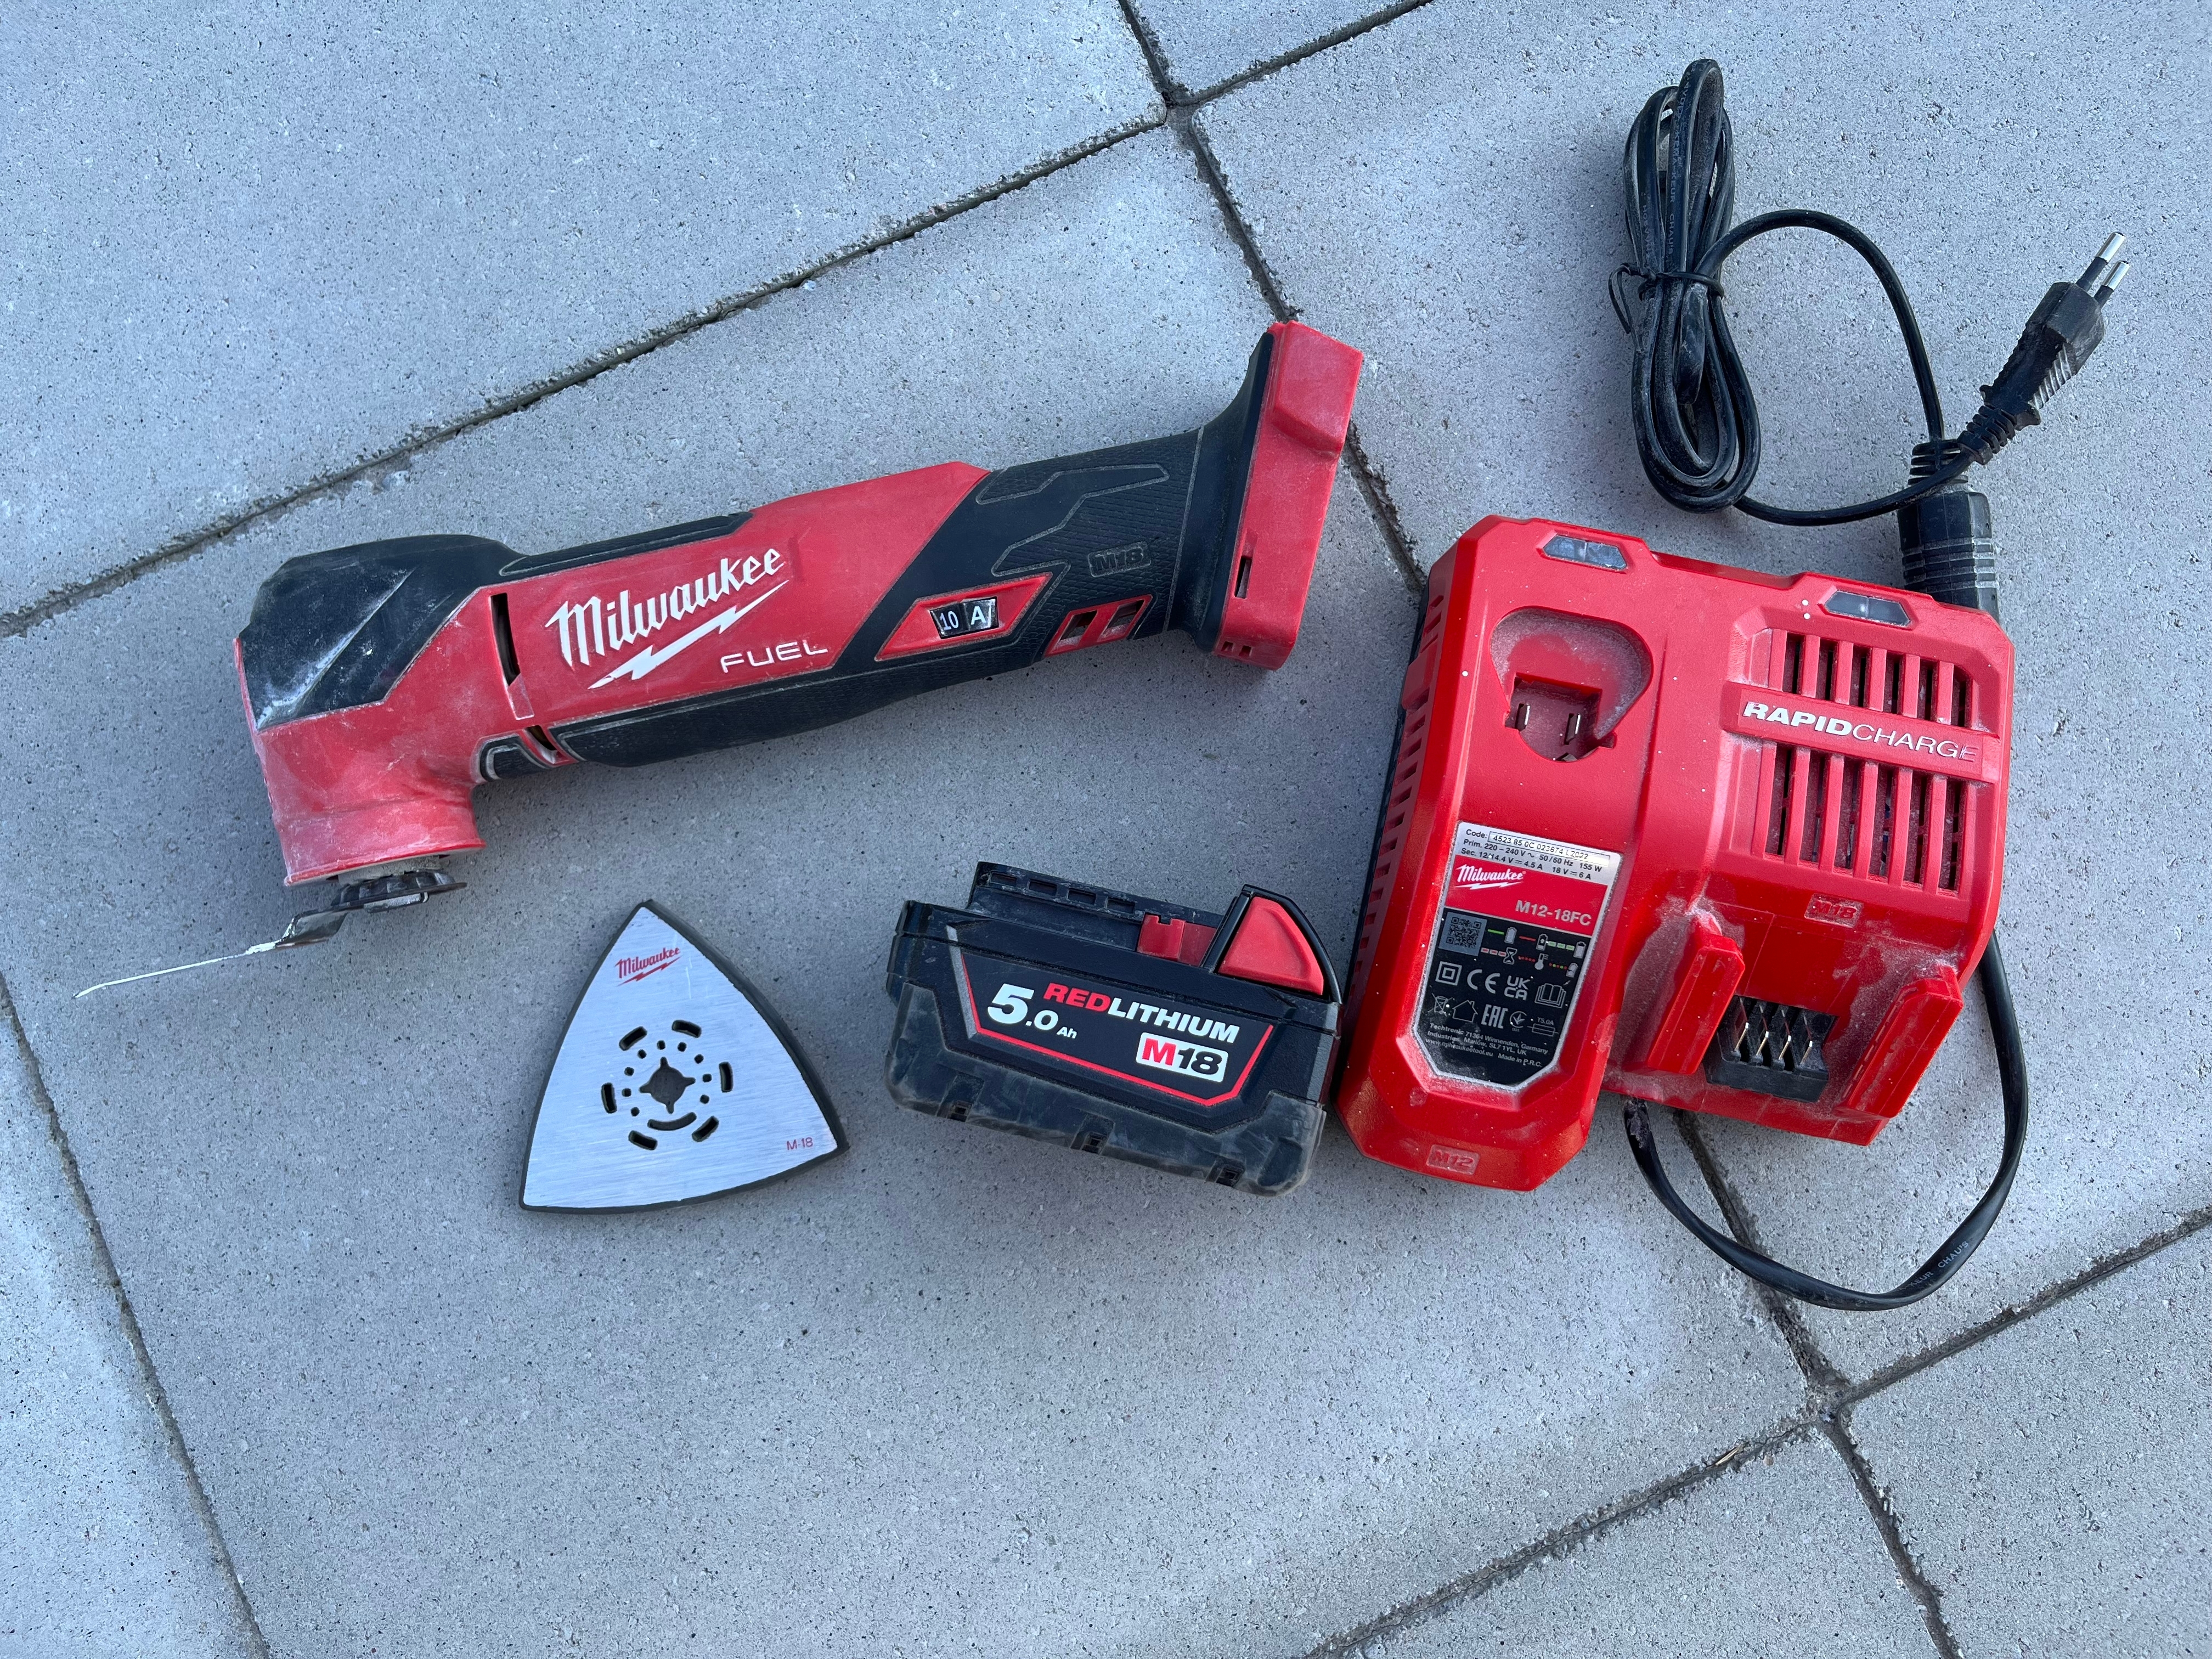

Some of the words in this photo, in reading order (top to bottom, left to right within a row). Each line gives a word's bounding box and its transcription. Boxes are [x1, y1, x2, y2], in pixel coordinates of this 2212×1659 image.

[1096, 549, 1144, 570] M18
[545, 548, 785, 667] Milwaukee
[970, 606, 986, 625] A
[720, 640, 828, 673] FUEL
[1743, 701, 1982, 762] RAPIDCHARGE
[1463, 838, 1483, 848] Prim.
[1465, 828, 1488, 838] Code:
[1493, 834, 1511, 843] 4523
[1461, 848, 1477, 856] Sec.
[1456, 864, 1523, 883] Milwaukee
[1515, 900, 1592, 927] M12-18FC
[1812, 900, 1859, 919] M18
[615, 947, 680, 978] Milwaukee
[1507, 975, 1531, 990] UK
[1504, 986, 1528, 1001] CA
[988, 983, 1059, 1031] 5.0
[1057, 1027, 1077, 1039] Ah
[1043, 983, 1240, 1043] REDLITHIUM
[1429, 1022, 1464, 1035] Techtronic
[1465, 1031, 1483, 1040] 71364
[1520, 1043, 1548, 1054] Germany
[1142, 1039, 1222, 1075] M18
[787, 1138, 813, 1150] M-18
[1431, 1150, 1474, 1167] M12
[1938, 1240, 1969, 1268] CHAU'S
